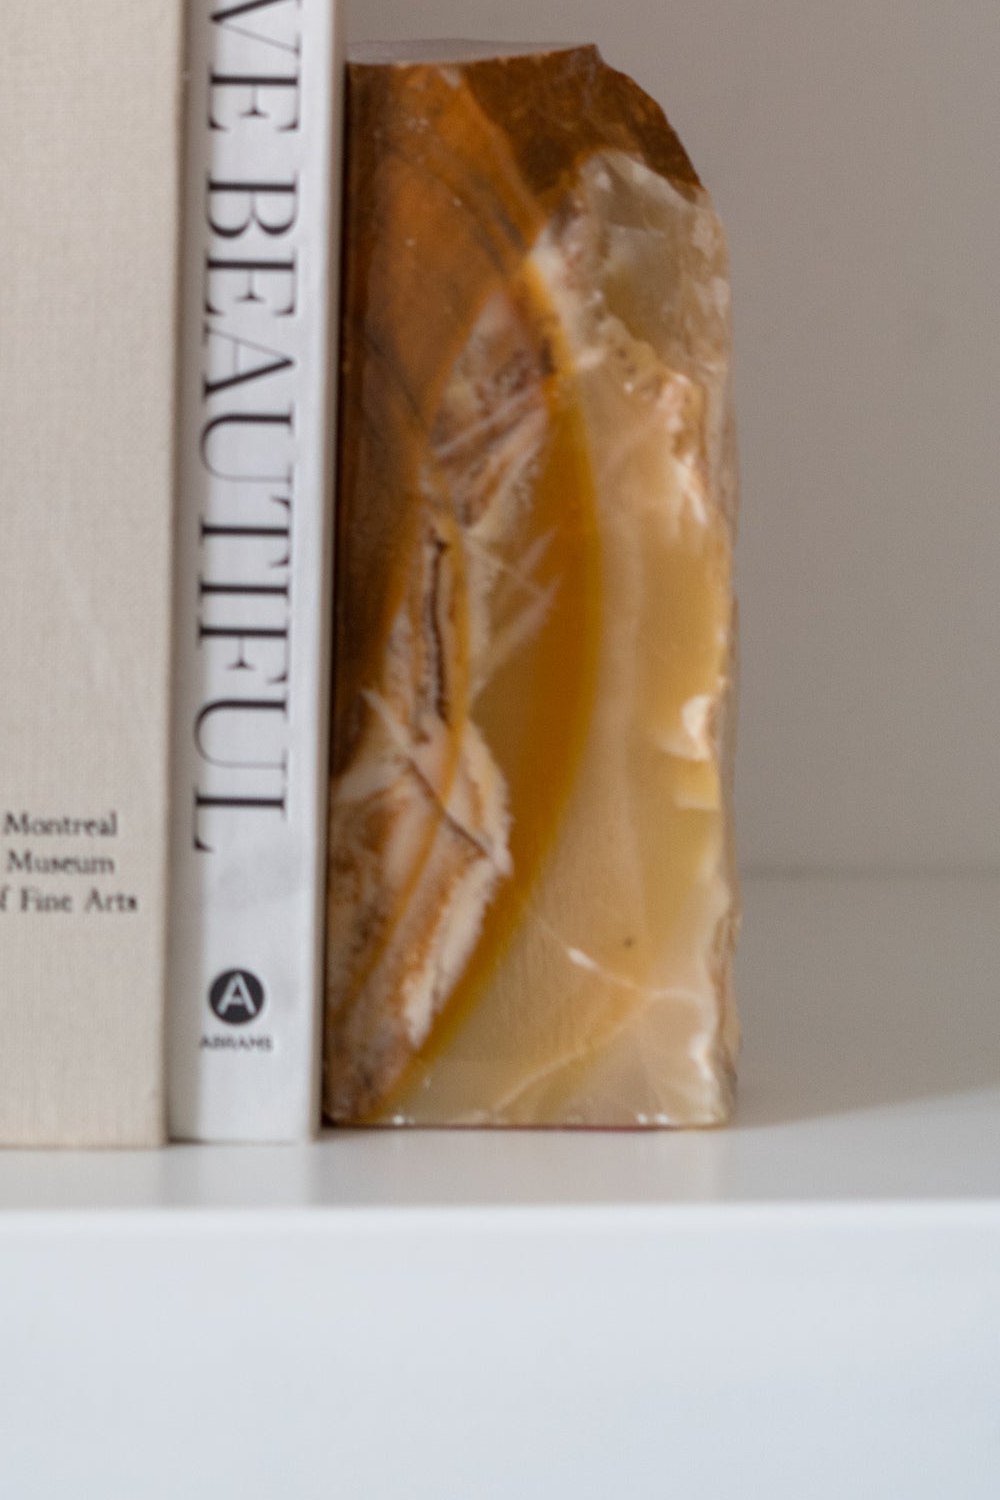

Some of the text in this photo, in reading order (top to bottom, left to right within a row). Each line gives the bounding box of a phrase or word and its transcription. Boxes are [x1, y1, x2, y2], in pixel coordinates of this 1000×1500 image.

[193, 168, 299, 852] BEAUTIFUL
[3, 810, 118, 837] Montreal
[6, 849, 115, 875] Museum
[21, 886, 73, 913] Fine
[85, 887, 138, 913] Arts
[214, 971, 259, 1017] A
